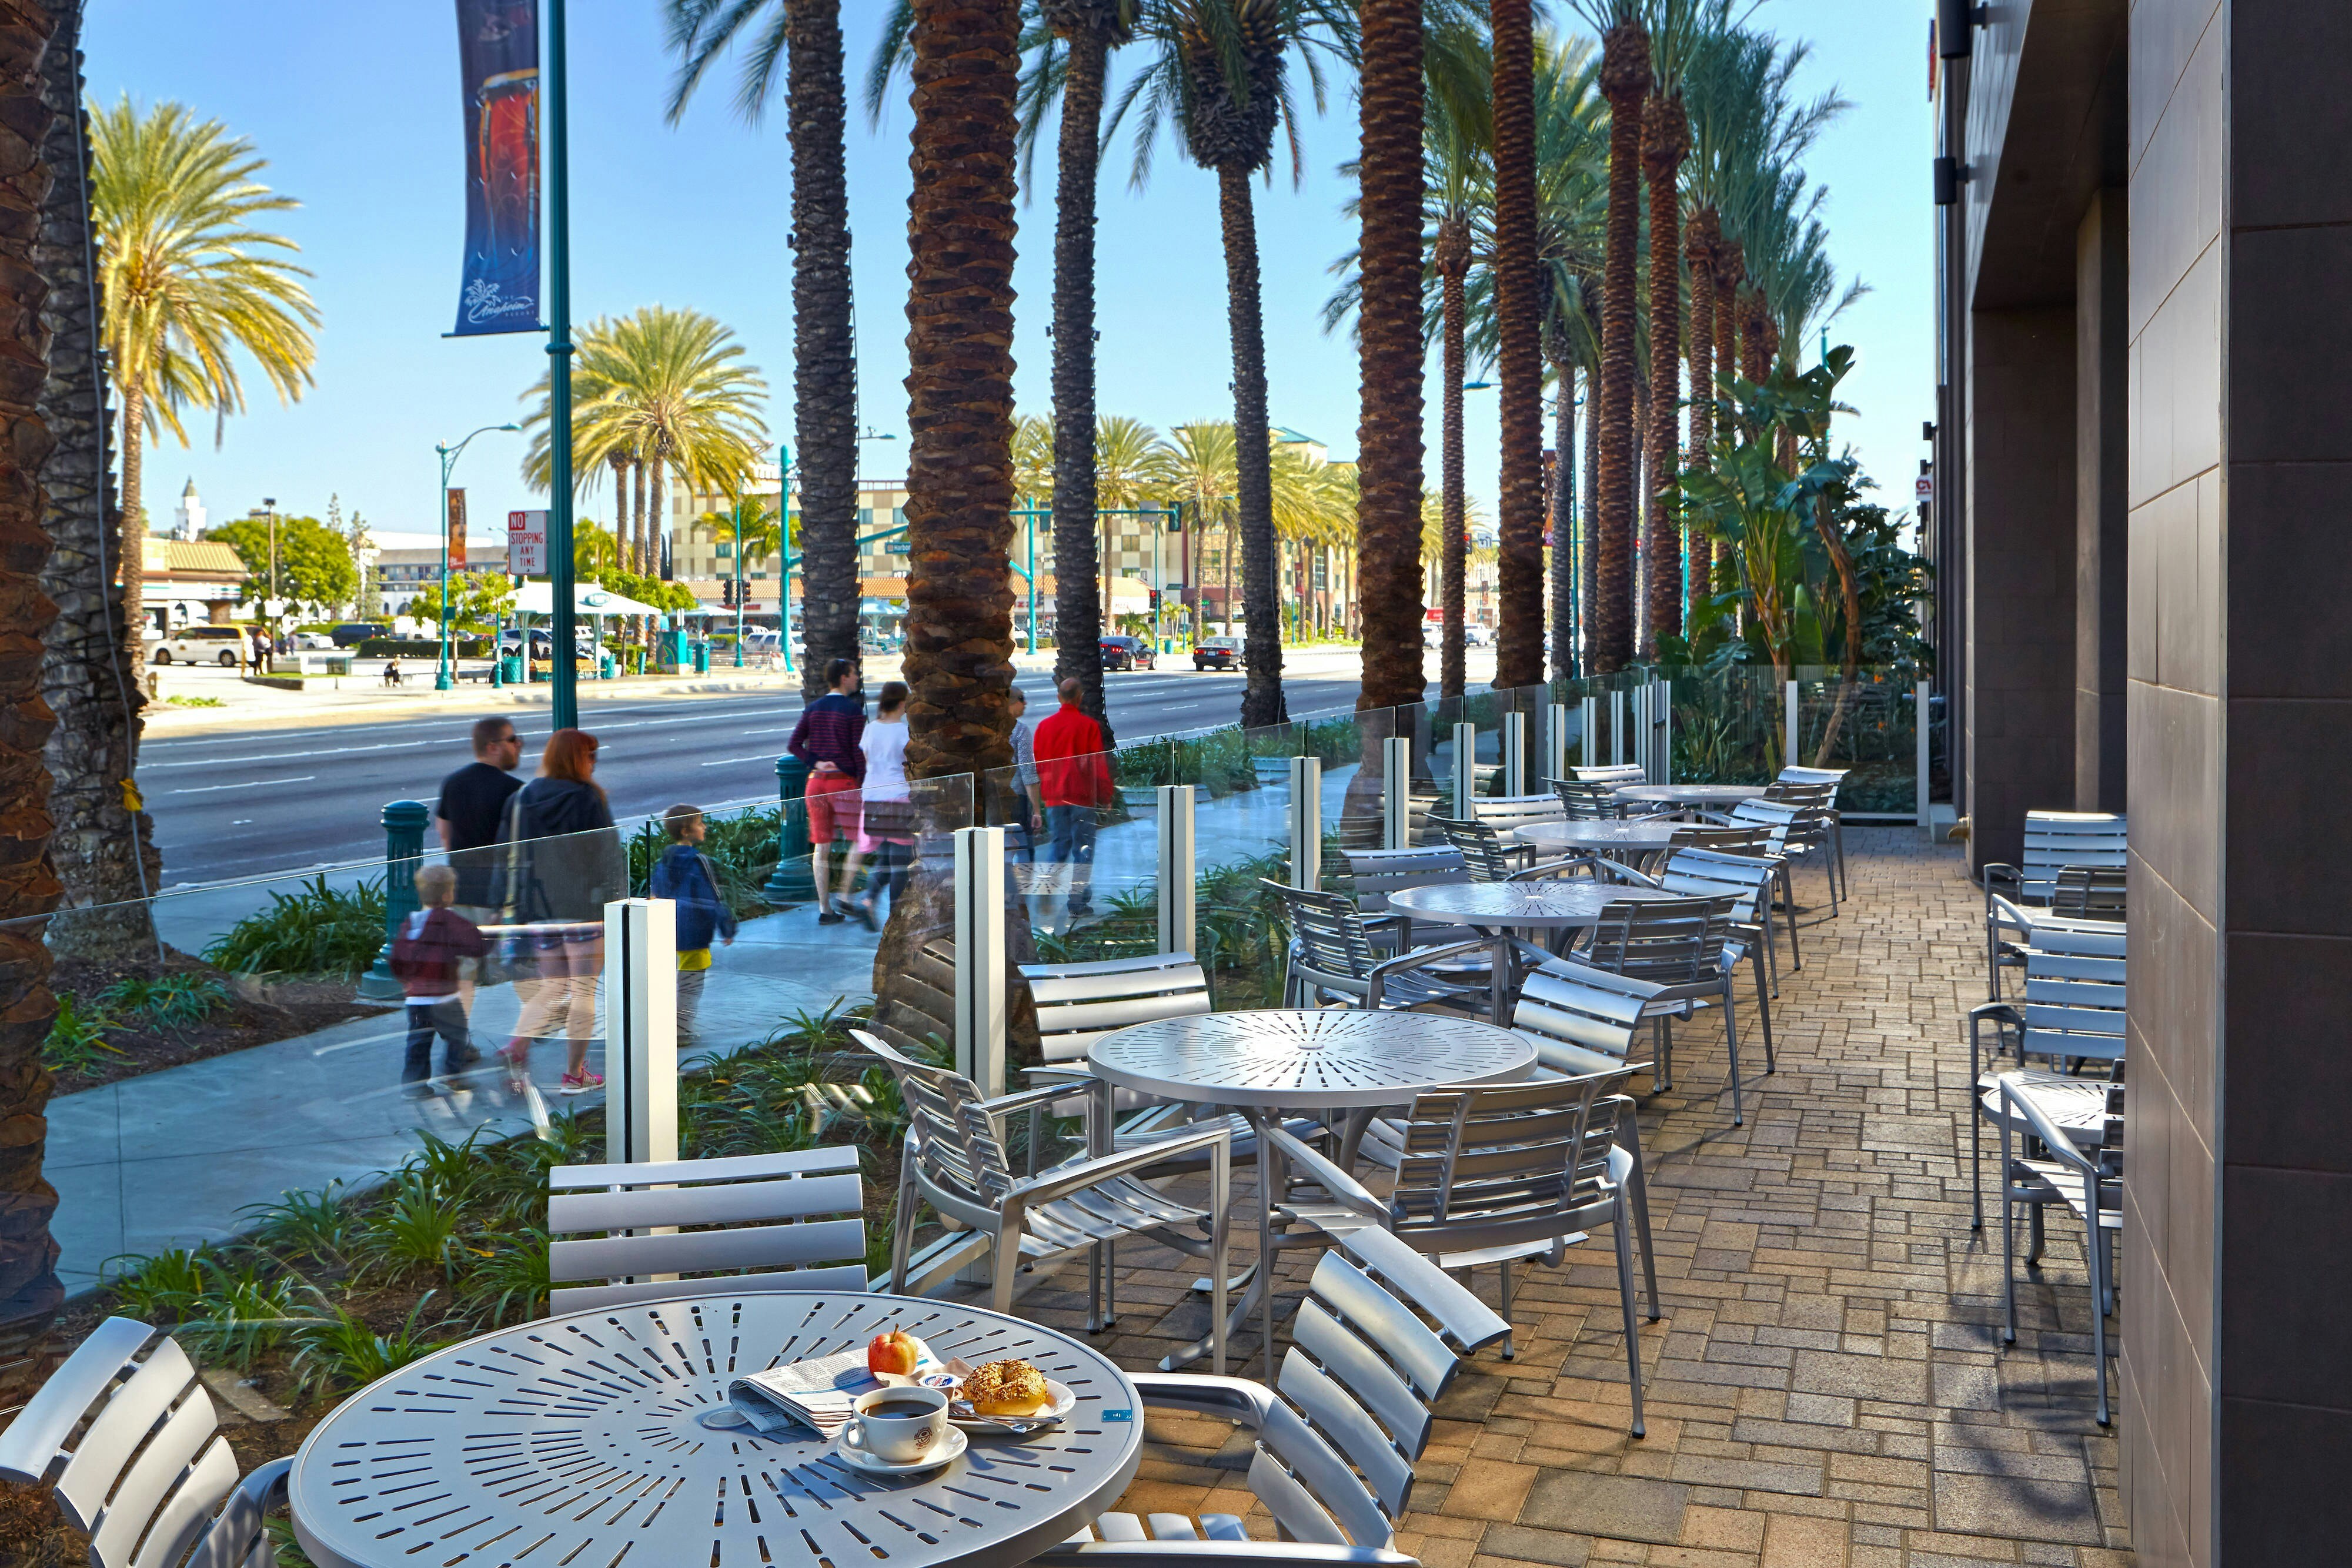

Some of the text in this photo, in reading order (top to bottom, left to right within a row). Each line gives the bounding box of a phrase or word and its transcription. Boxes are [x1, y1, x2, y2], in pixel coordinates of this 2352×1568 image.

[511, 513, 524, 529] NO
[511, 532, 543, 544] STOPPING
[520, 546, 534, 554] ANY
[520, 557, 536, 567] TIME
